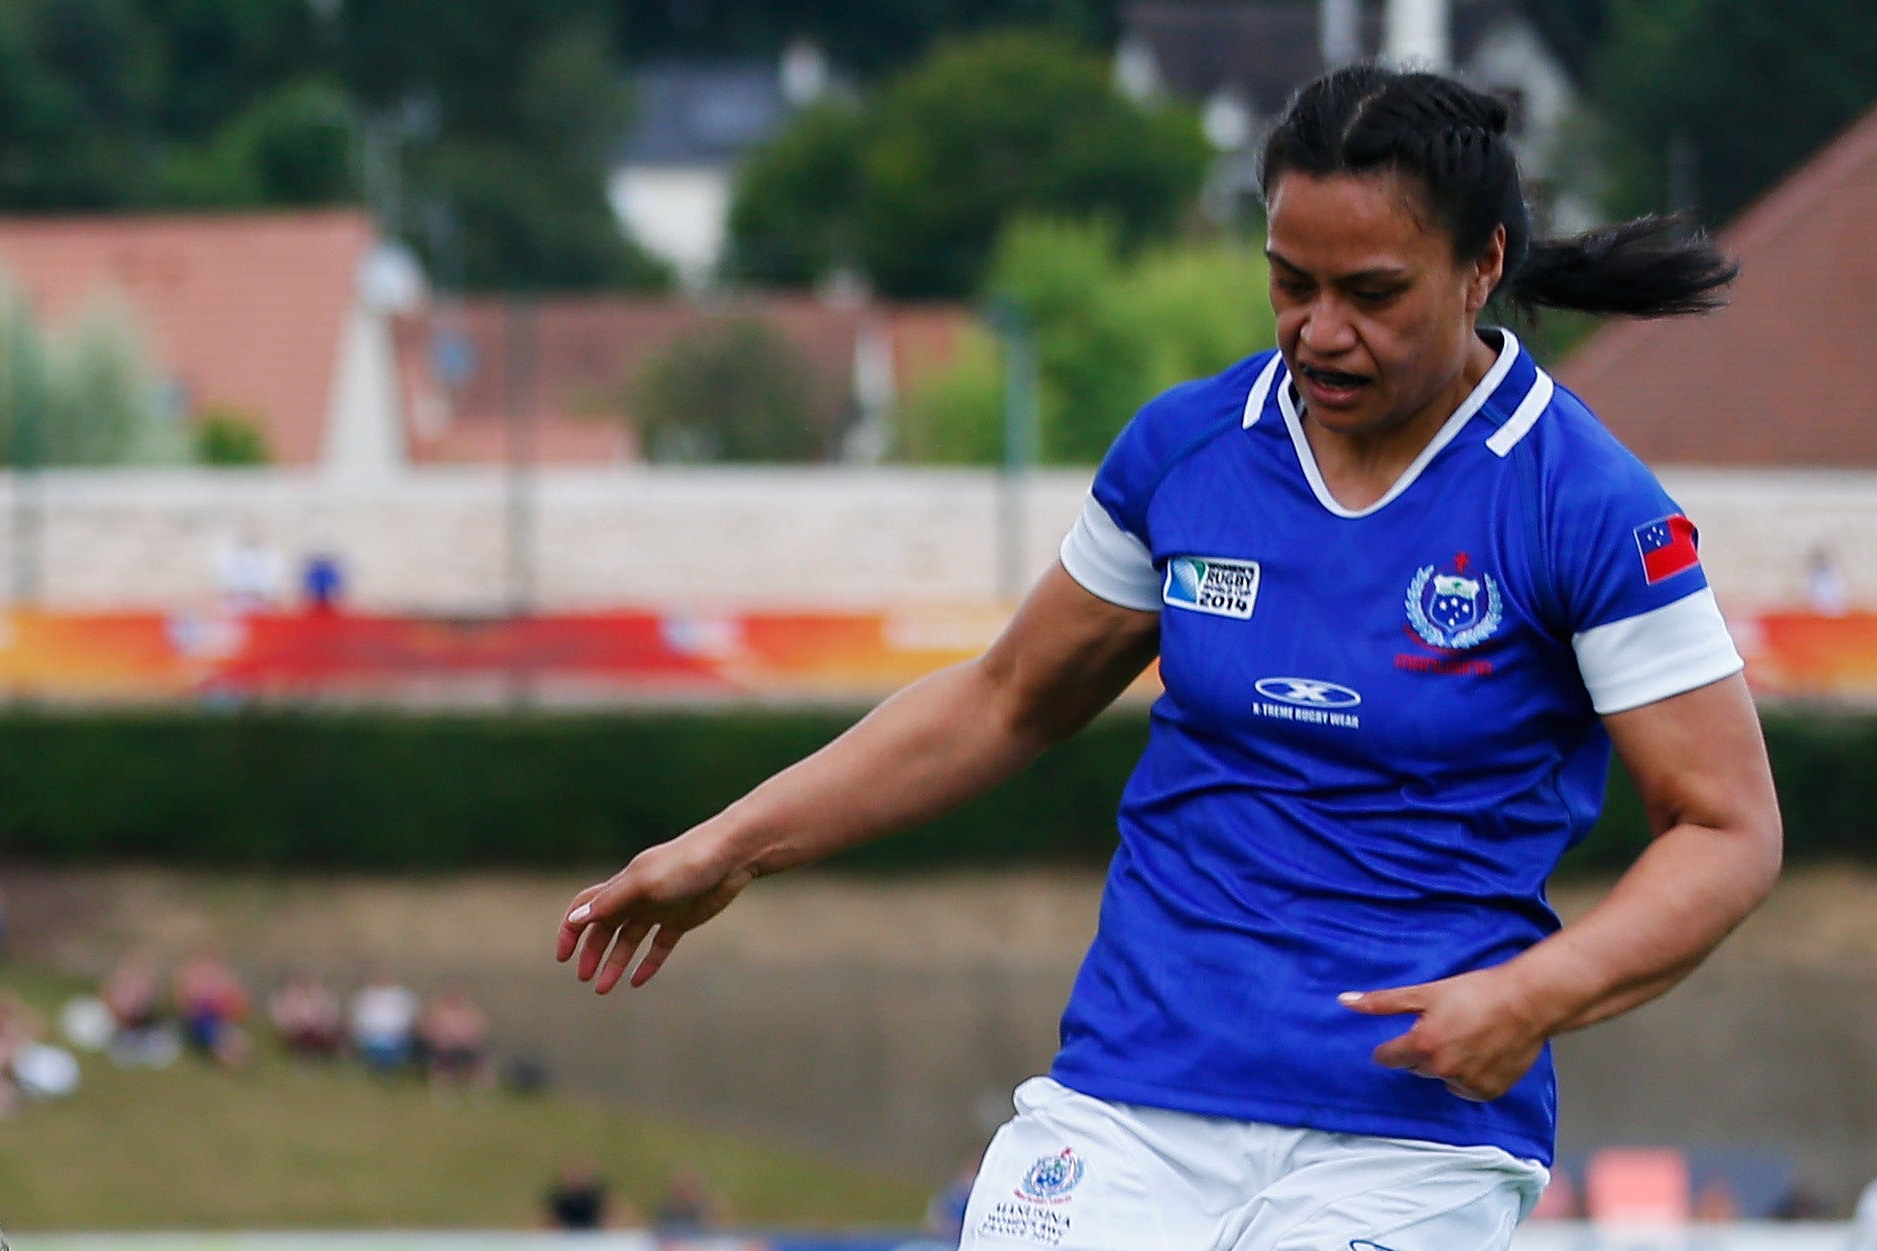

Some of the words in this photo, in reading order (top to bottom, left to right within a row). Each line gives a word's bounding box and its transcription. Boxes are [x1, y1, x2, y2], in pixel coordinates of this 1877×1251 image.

[1207, 568, 1252, 589] RUGBY
[1200, 592, 1248, 612] 2014
[1294, 707, 1328, 724] RUGBY
[1330, 712, 1359, 729] WEAR
